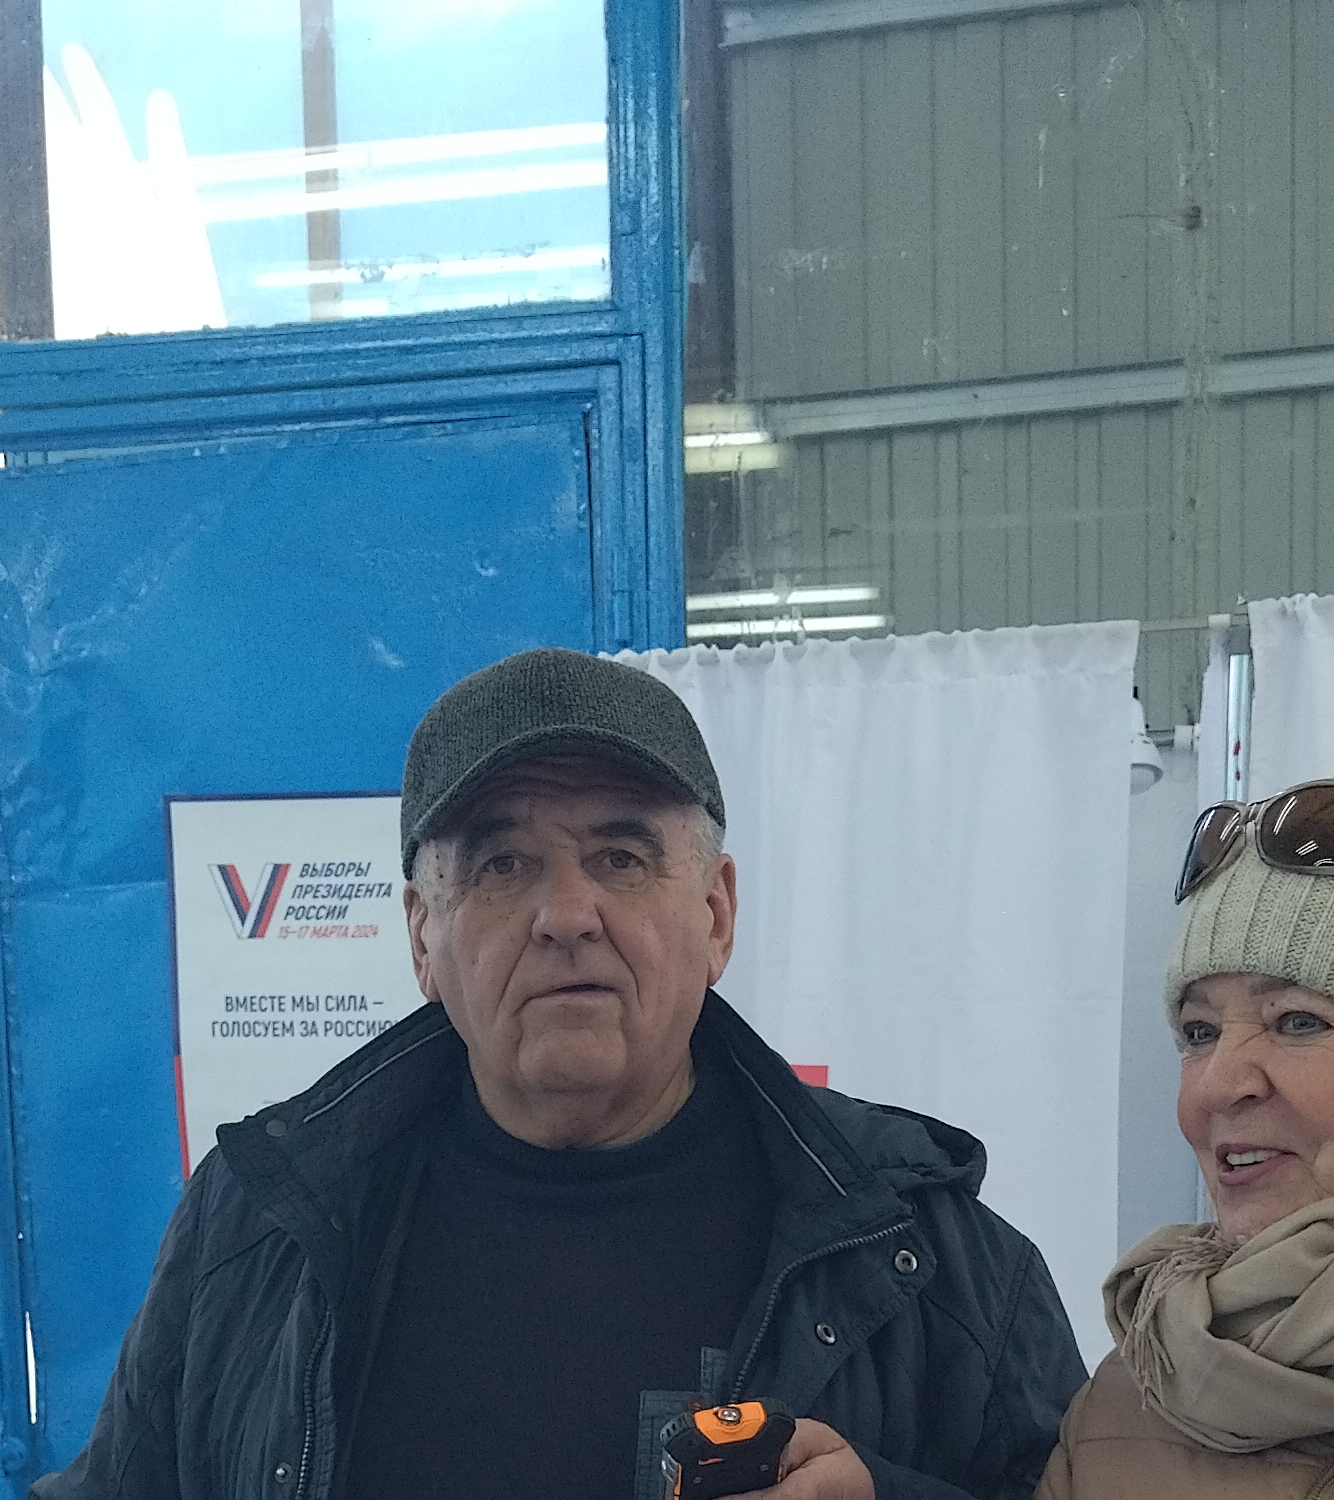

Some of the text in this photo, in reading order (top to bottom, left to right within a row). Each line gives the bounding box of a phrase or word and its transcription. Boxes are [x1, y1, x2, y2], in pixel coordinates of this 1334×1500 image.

[299, 862, 372, 878] ВЫБОРЫ
[291, 883, 392, 900] ПРЕЗИДЕНТА
[283, 905, 349, 920] РОССИИ
[310, 925, 349, 938] МАРТА
[351, 925, 379, 938] 2024
[225, 995, 286, 1012] ВМЕСТЕ
[292, 995, 320, 1012] МЫ
[325, 995, 368, 1012] СИЛА
[211, 1020, 398, 1037] ГОЛОСУЕМ ЗА РОССИЮ
